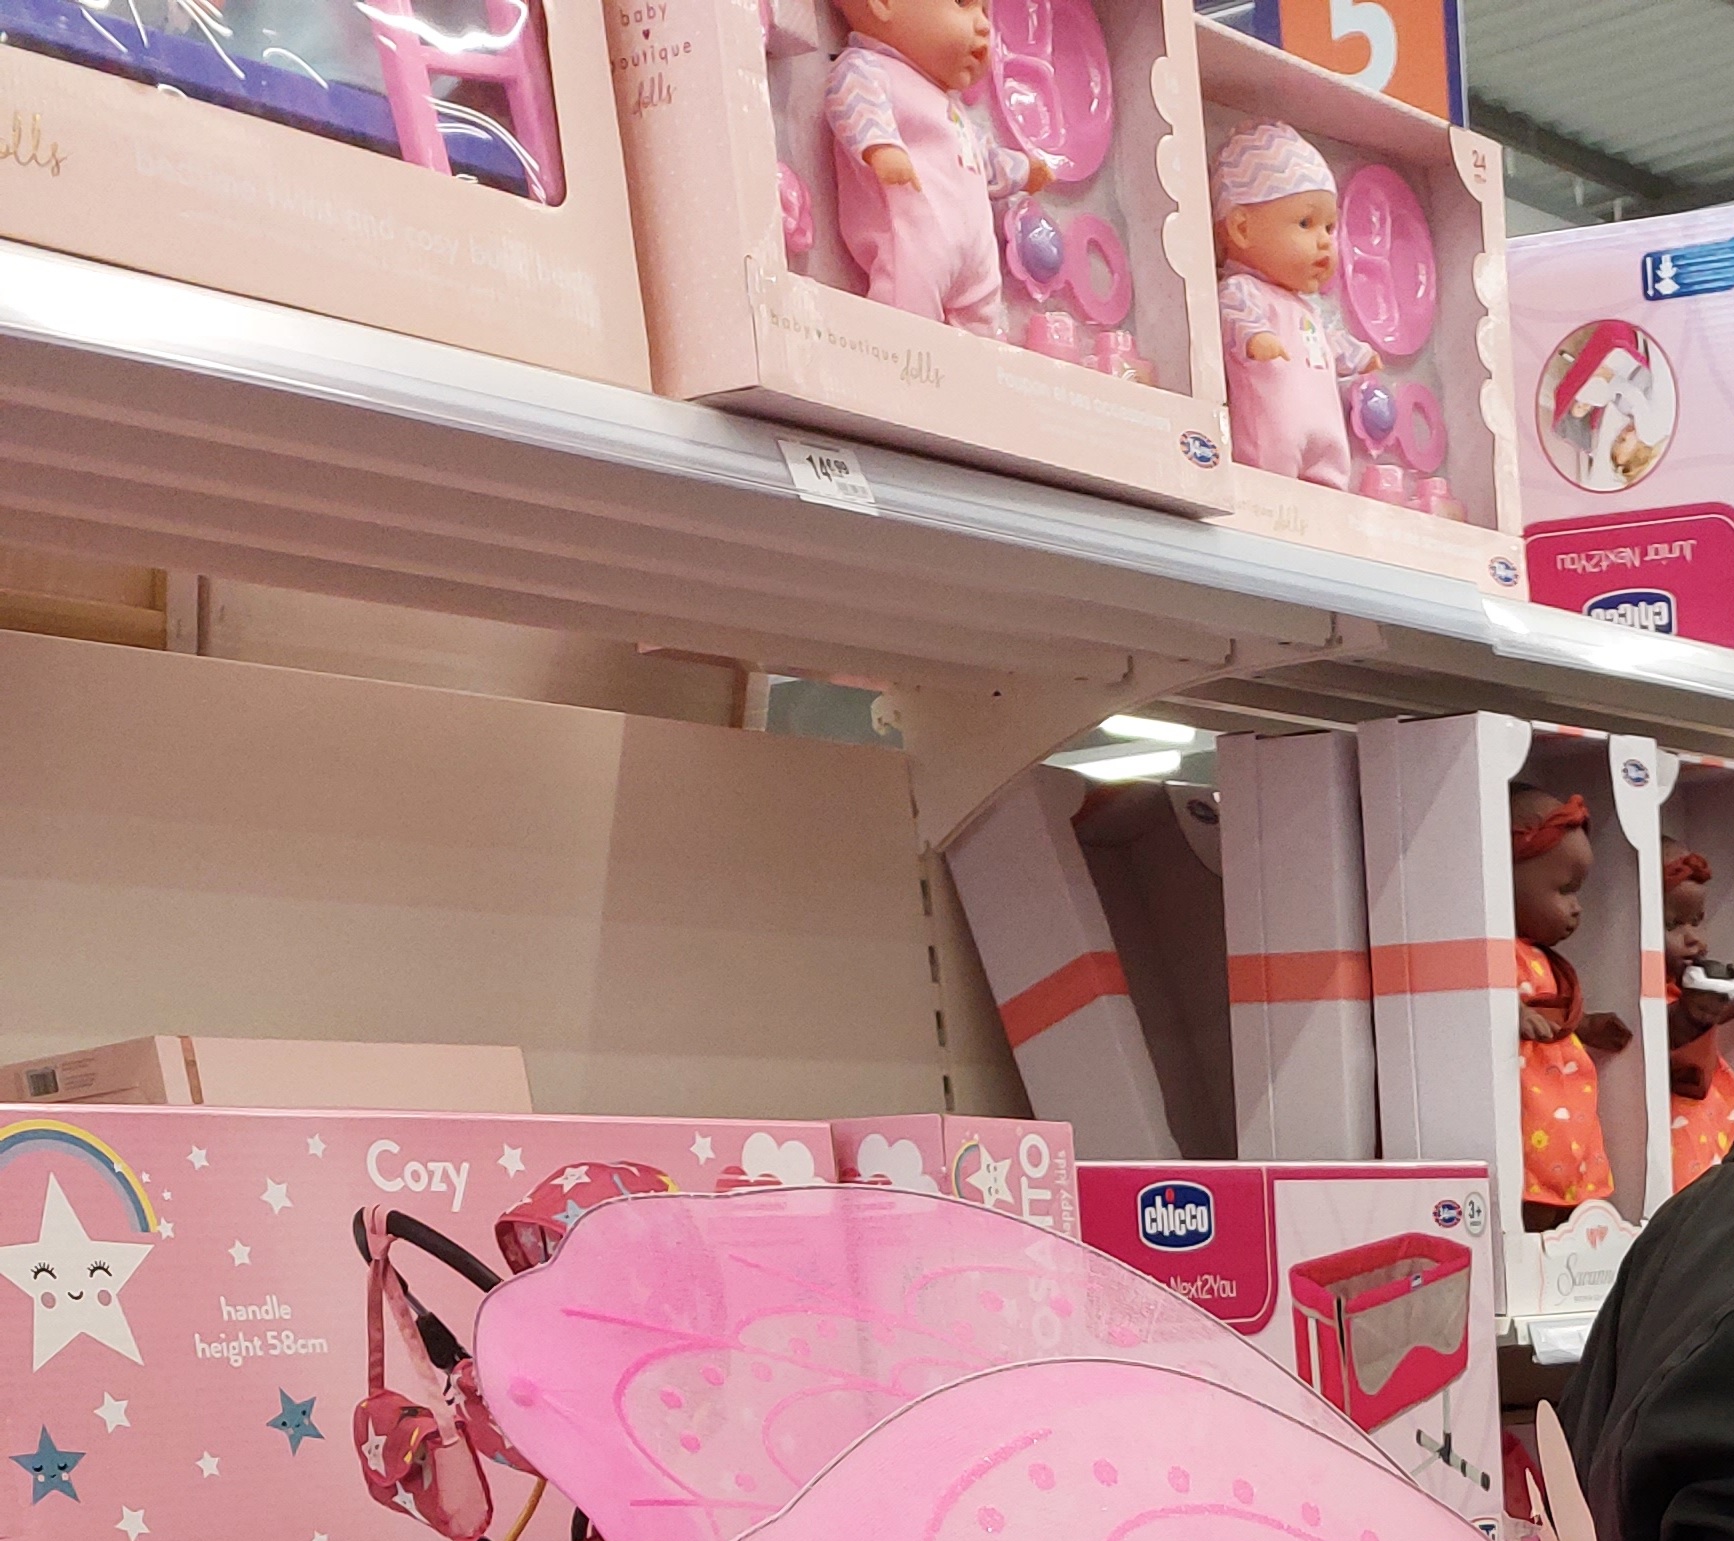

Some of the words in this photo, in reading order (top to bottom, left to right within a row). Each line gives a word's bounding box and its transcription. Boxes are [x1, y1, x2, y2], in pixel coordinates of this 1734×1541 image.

[366, 1139, 470, 1214] Cozy
[1053, 1149, 1068, 1187] kids
[1144, 1187, 1209, 1237] chicco
[219, 1294, 293, 1325] handle
[194, 1330, 265, 1369] height
[266, 1330, 329, 1358] 58cm
